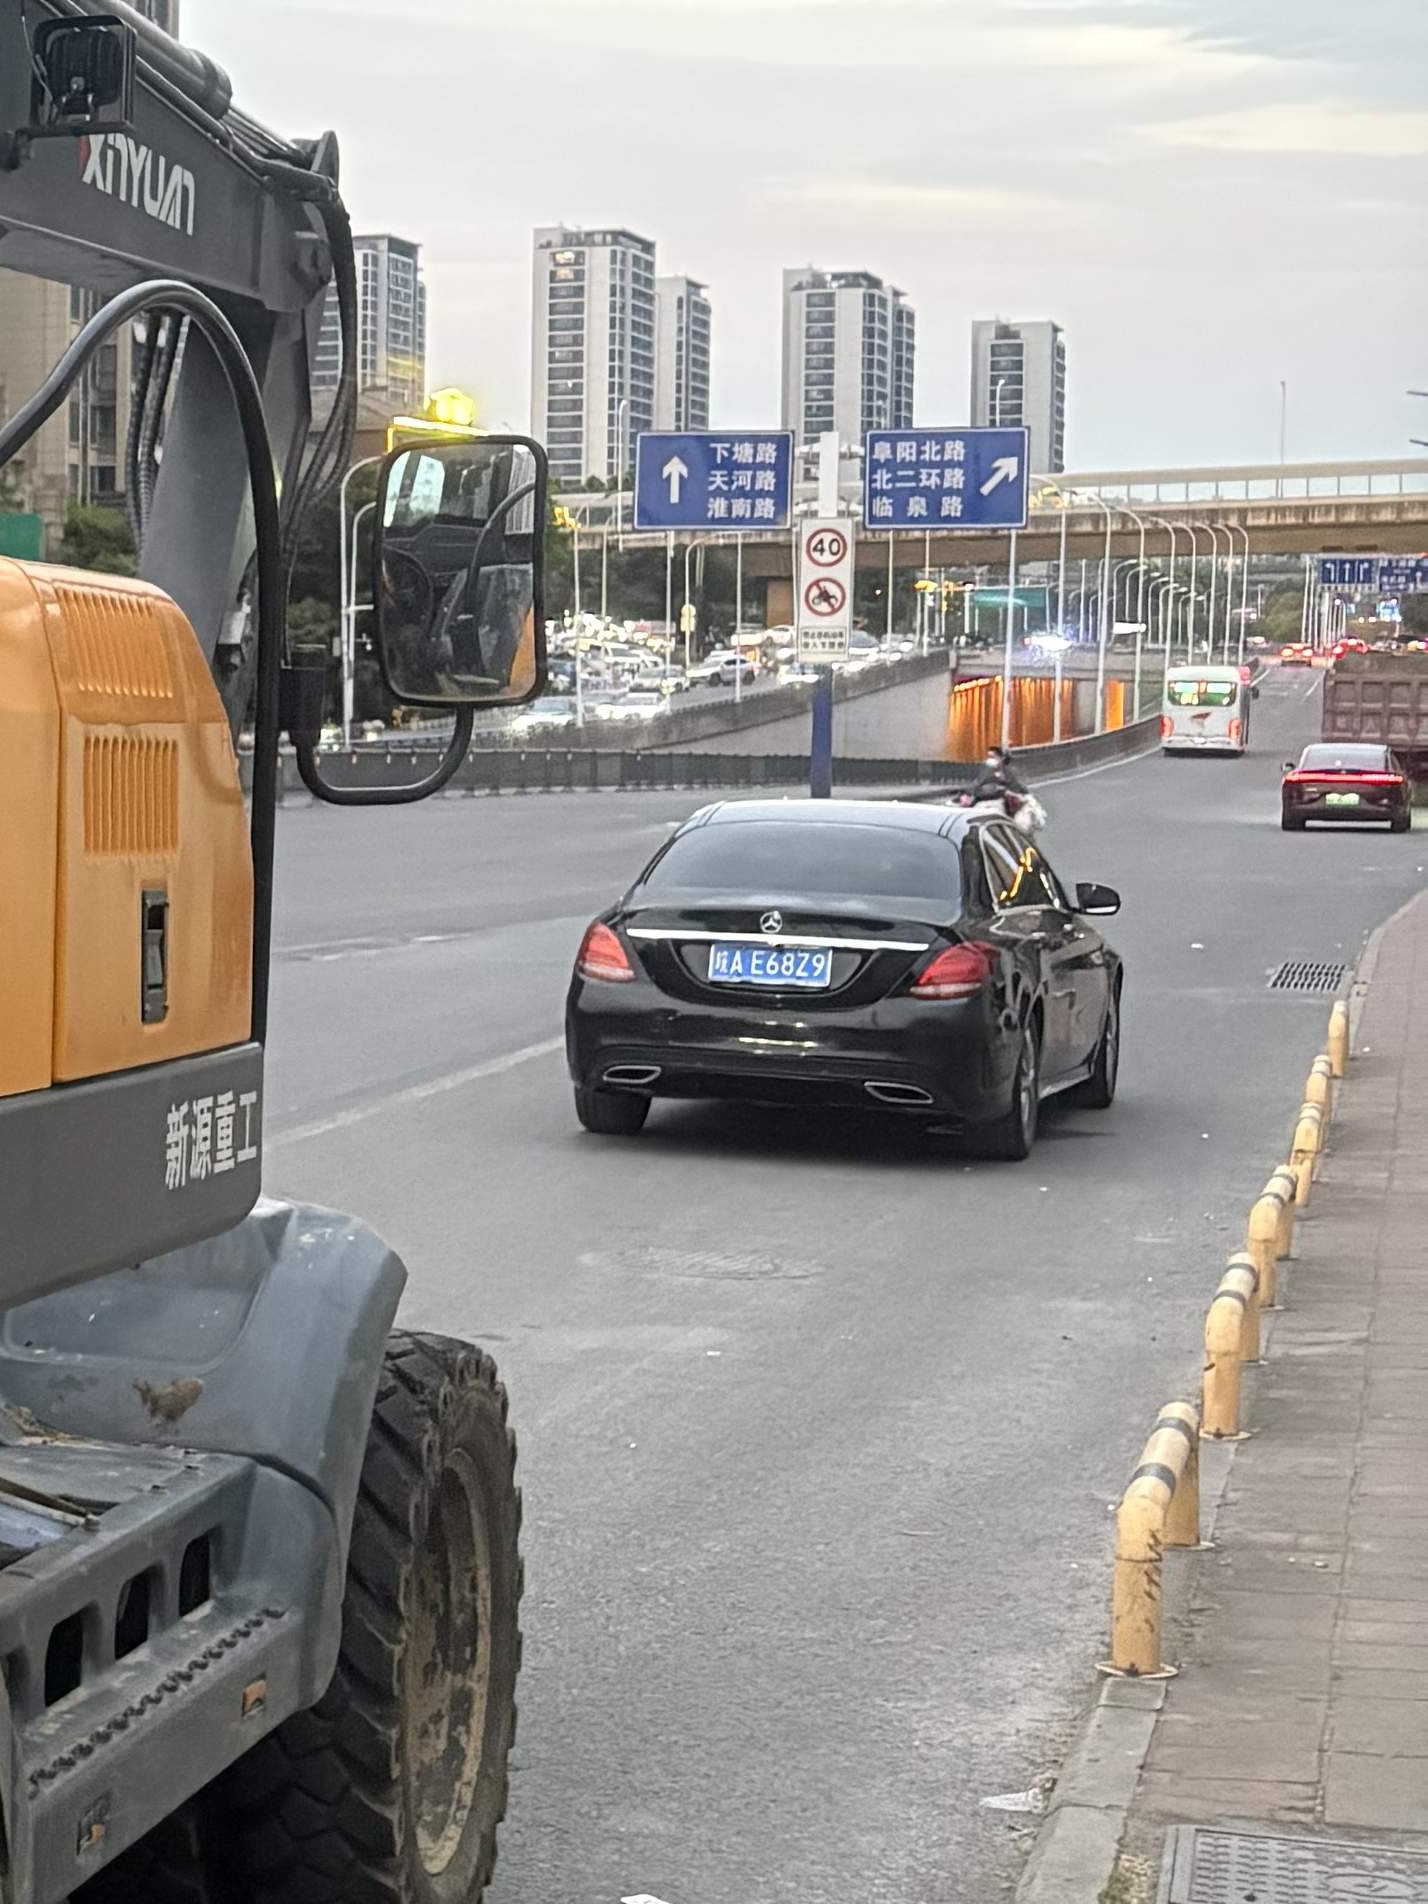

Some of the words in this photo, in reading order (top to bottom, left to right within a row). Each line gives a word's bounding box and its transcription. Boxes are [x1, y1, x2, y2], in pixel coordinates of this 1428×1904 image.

[709, 442, 777, 464] 下塘路
[872, 440, 965, 463] 阜阳北路
[707, 470, 776, 491] 天河路
[871, 467, 965, 490] 北二环路
[707, 497, 775, 519] 淮南路
[812, 537, 841, 557] 40
[165, 1090, 257, 1191] 新源重工
